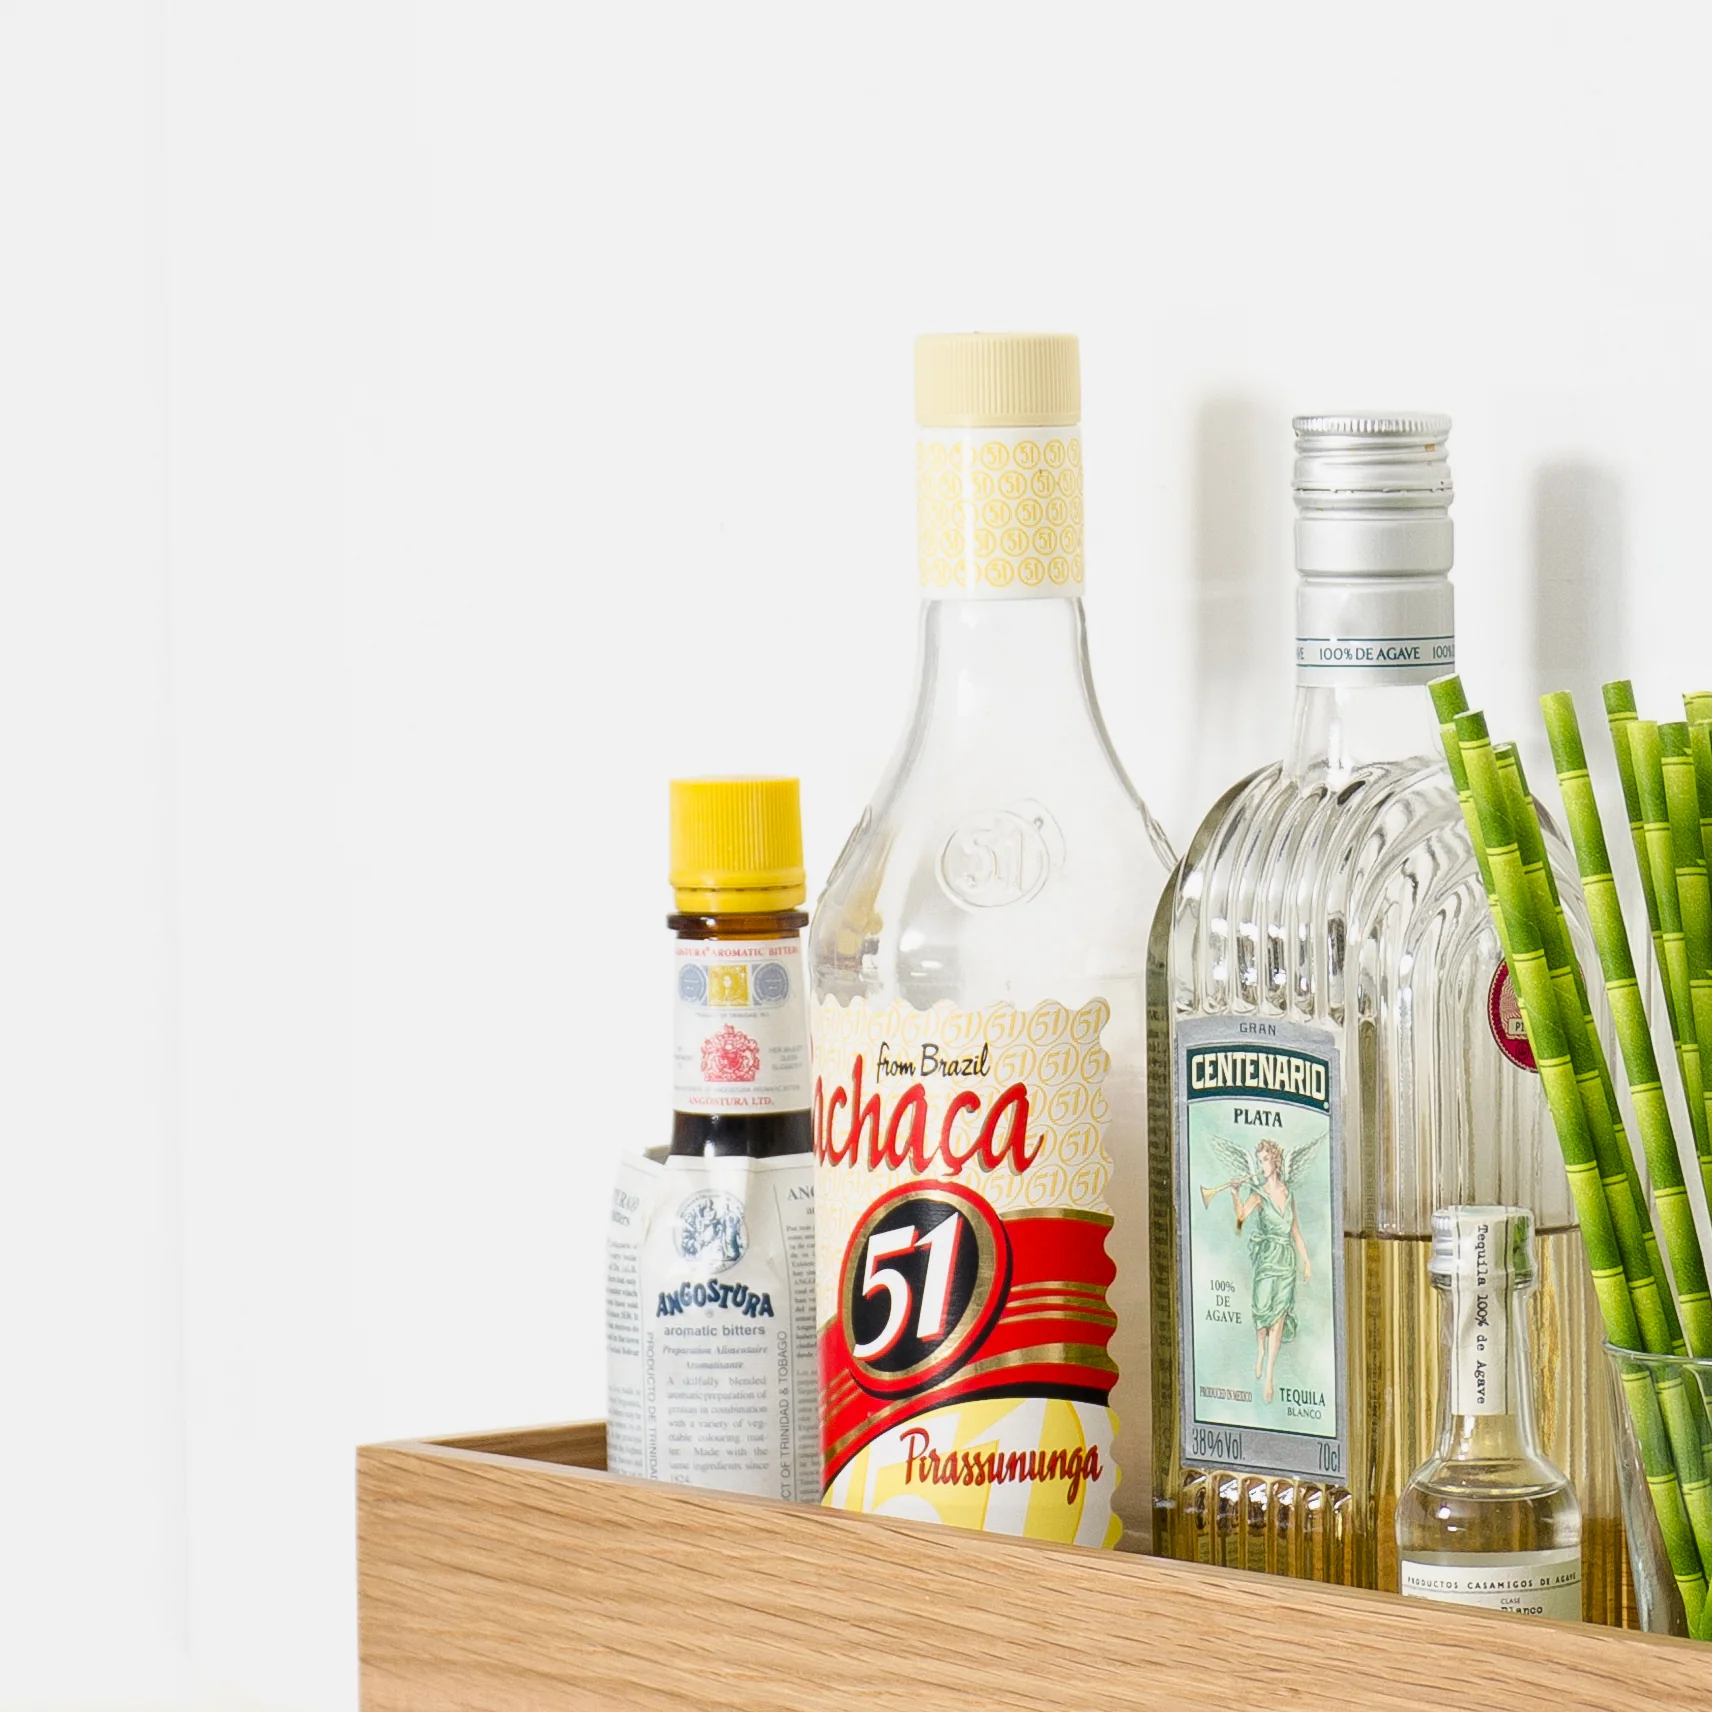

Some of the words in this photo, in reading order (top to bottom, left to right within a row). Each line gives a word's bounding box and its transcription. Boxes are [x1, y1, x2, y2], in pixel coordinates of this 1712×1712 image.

[1319, 648, 1352, 660] 100%
[1355, 647, 1373, 660] DE
[1376, 646, 1420, 660] AGAVE
[1239, 1022, 1276, 1036] GRAN
[876, 1041, 916, 1084] from
[921, 1042, 991, 1077] Brazil
[1191, 1051, 1326, 1101] CENTENARIO
[689, 1097, 748, 1106] ANGOSTURA
[811, 1052, 1044, 1176] achaça
[1233, 1108, 1283, 1128] PLATA
[1475, 1225, 1488, 1286] Tequila
[853, 1211, 962, 1362] 51
[1210, 1279, 1236, 1293] 100%
[656, 1278, 774, 1318] ANGOSTURA
[1216, 1295, 1231, 1308] DE
[1205, 1310, 1242, 1324] AGAVE
[1475, 1295, 1489, 1327] 100%
[664, 1325, 718, 1337] aromatic
[722, 1325, 766, 1337] bitters
[1476, 1334, 1487, 1351] de
[646, 1332, 656, 1402] PRODUCTO
[777, 1331, 789, 1386] TOBAGO
[779, 1388, 789, 1396] &
[1473, 1361, 1487, 1405] Agave
[1279, 1387, 1326, 1407] TEQUILA
[648, 1406, 656, 1420] DE
[1287, 1407, 1322, 1420] BLANCO
[779, 1399, 790, 1459] TRINIDAD
[1192, 1428, 1224, 1458] 38%
[1225, 1431, 1246, 1461] Vol.
[1317, 1440, 1341, 1473] 70cl
[900, 1427, 1103, 1505] Pirassununga
[1407, 1576, 1459, 1590] PRODUCTOS
[1467, 1579, 1533, 1590] CASAMIGOS
[1540, 1577, 1550, 1587] DE
[1555, 1572, 1577, 1584] AGAVE
[1500, 1597, 1520, 1605] CLASE
